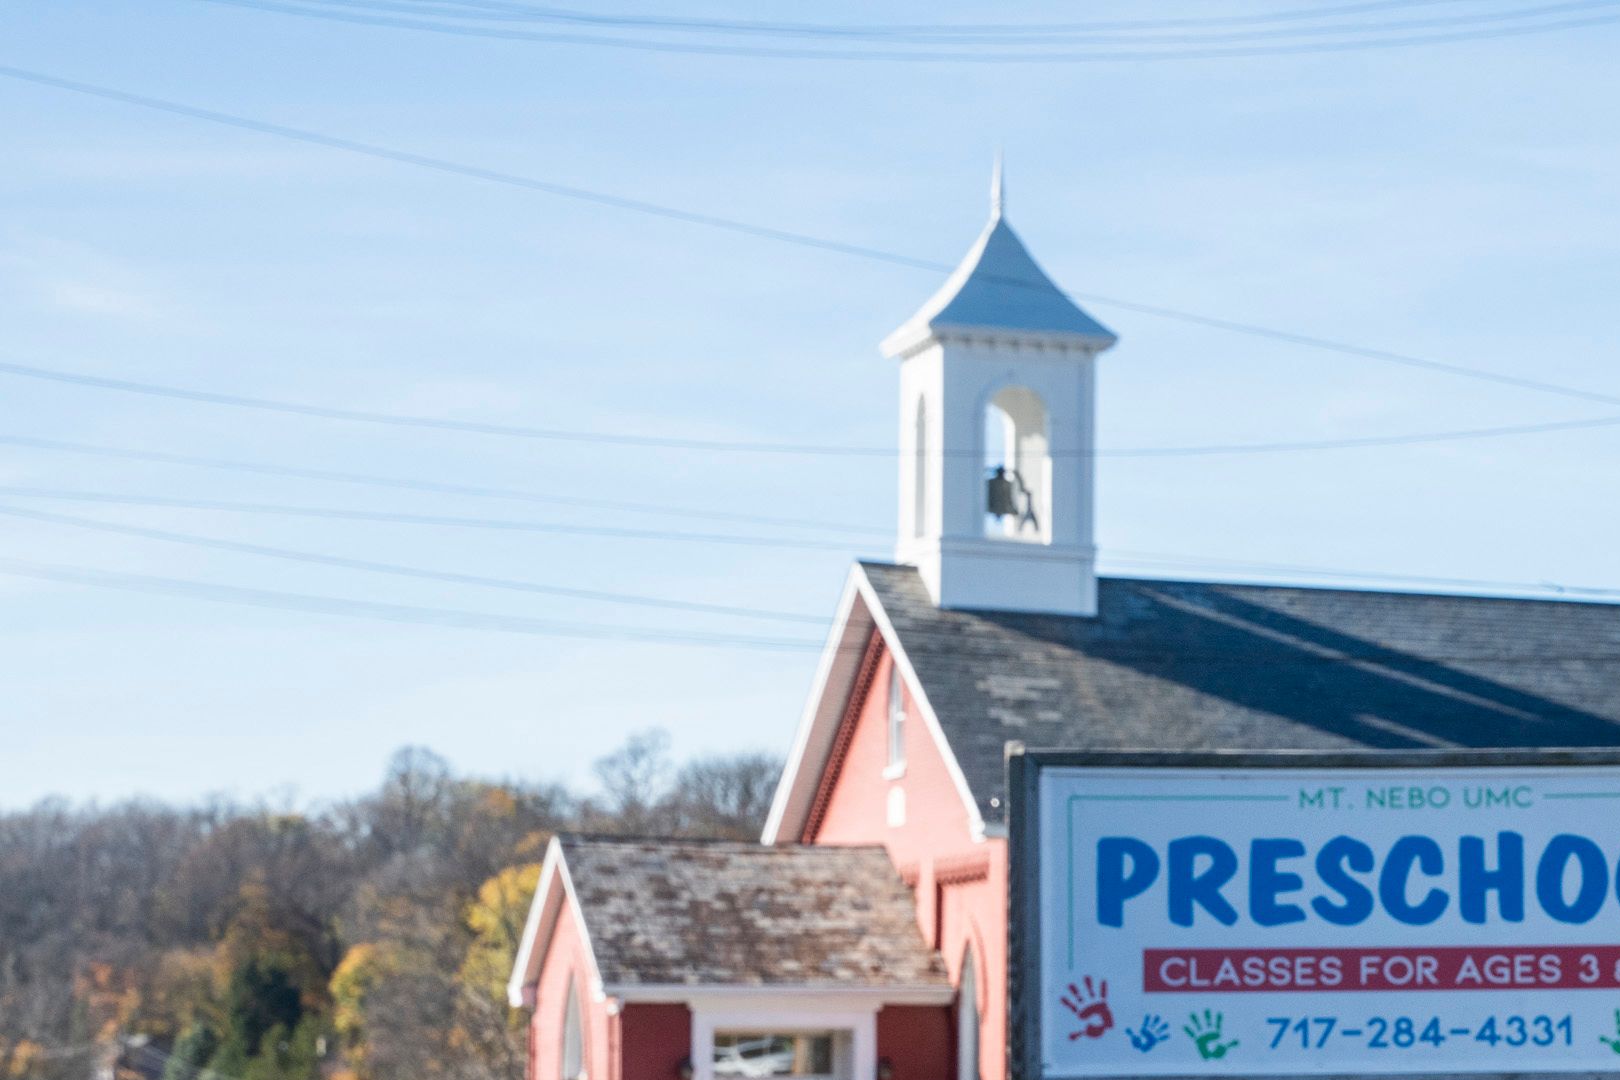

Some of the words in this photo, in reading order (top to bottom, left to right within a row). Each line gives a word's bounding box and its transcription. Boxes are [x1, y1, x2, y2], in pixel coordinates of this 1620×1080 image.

[1299, 785, 1355, 810] MT.
[1366, 785, 1451, 810] NEBO
[1463, 784, 1534, 809] UMC
[1160, 956, 1342, 985] CLASSES
[1361, 956, 1438, 984] FOR
[1456, 954, 1562, 984] AGES
[1580, 954, 1600, 983] 3
[1267, 1014, 1573, 1050] 717-284-4331
